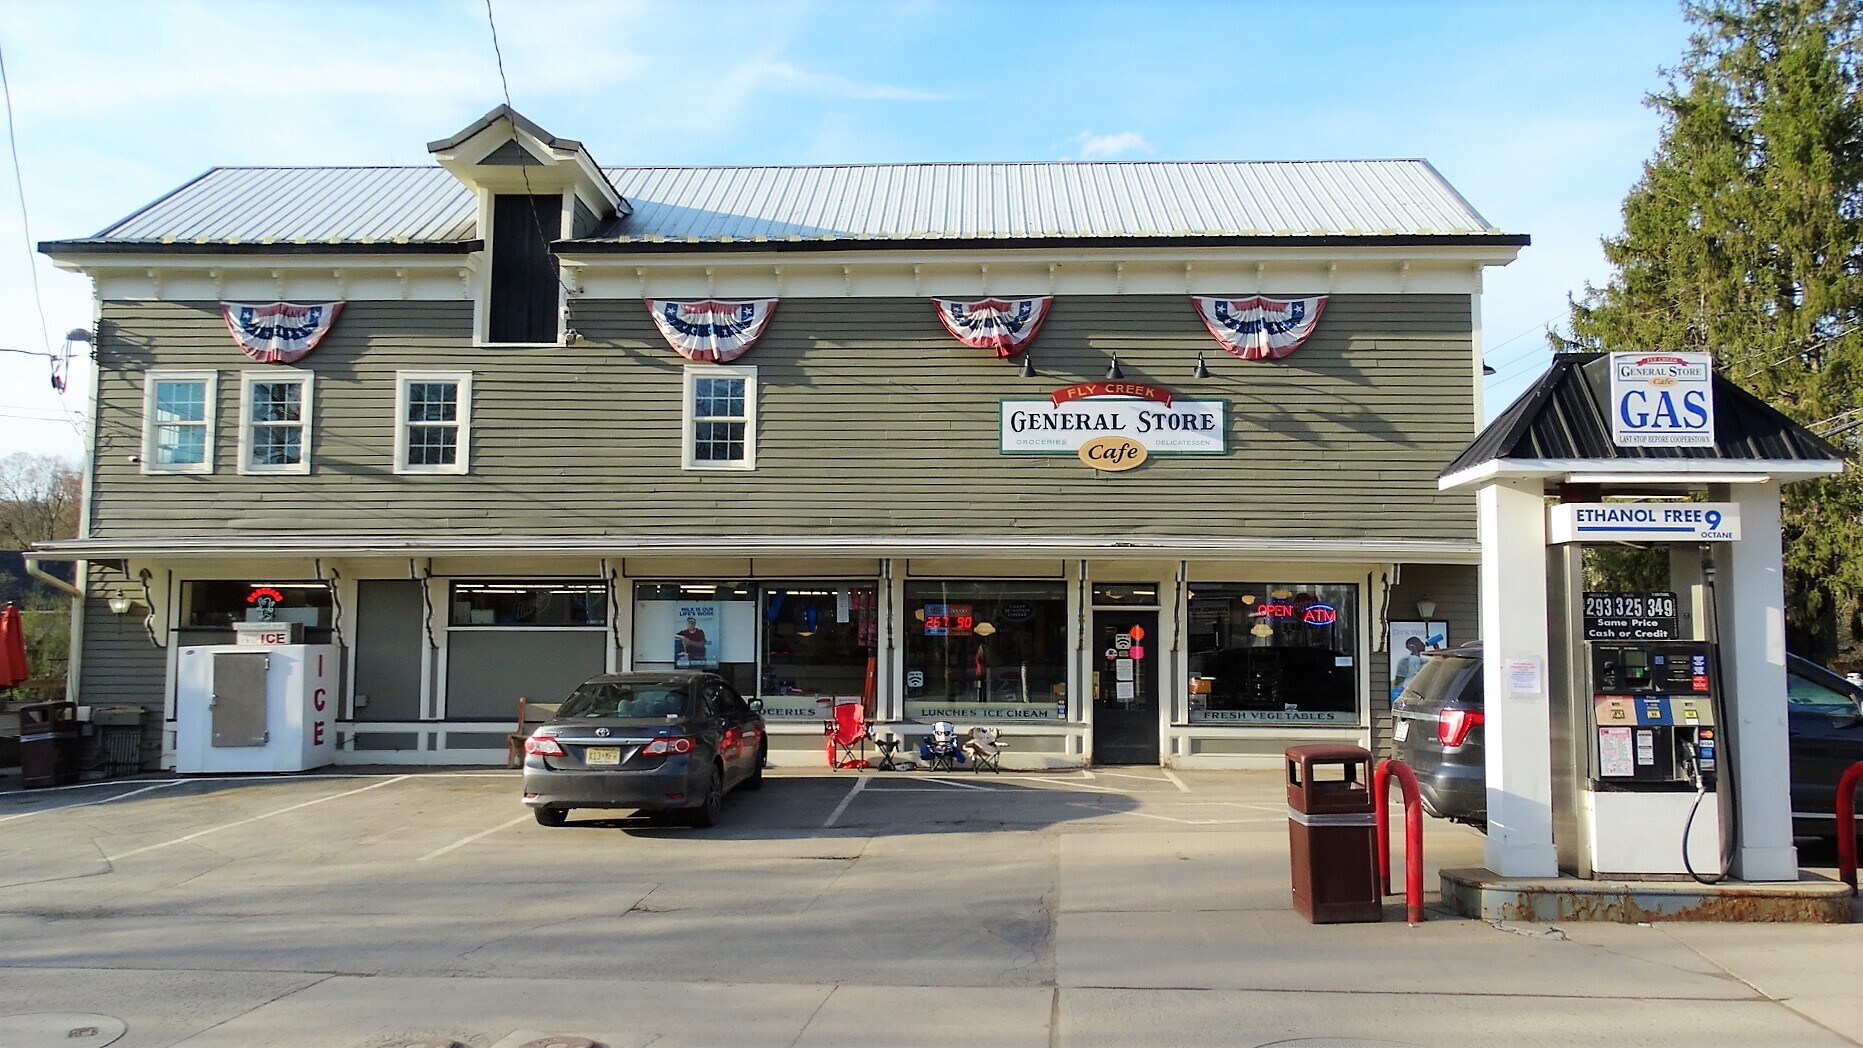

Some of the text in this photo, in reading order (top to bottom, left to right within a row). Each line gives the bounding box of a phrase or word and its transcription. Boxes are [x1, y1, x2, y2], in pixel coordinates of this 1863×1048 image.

[1621, 366, 1702, 377] GENERAL STORE
[1653, 378, 1674, 386] Cafe
[1067, 384, 1155, 398] FLY CREEK
[1620, 390, 1708, 428] GAS
[1011, 410, 1215, 433] GENERAL STORE
[1619, 435, 1709, 443] LAST STOP BEFORE COOPERSTOWN
[1088, 443, 1138, 463] Cafe
[1576, 509, 1722, 530] ETHANOL FREE 9
[1257, 604, 1293, 617] OPEN
[1303, 609, 1337, 622] ATM
[957, 616, 972, 628] 90
[1597, 618, 1659, 627] Same Price
[261, 633, 285, 644] ICE
[1589, 629, 1615, 637] Cash
[1634, 629, 1668, 638] Credit
[313, 653, 326, 746] ICE
[760, 708, 816, 716] OCERIES
[921, 709, 1048, 717] LUNCHES ICE CREAM
[1203, 711, 1335, 720] FRESH VEGETABLES
